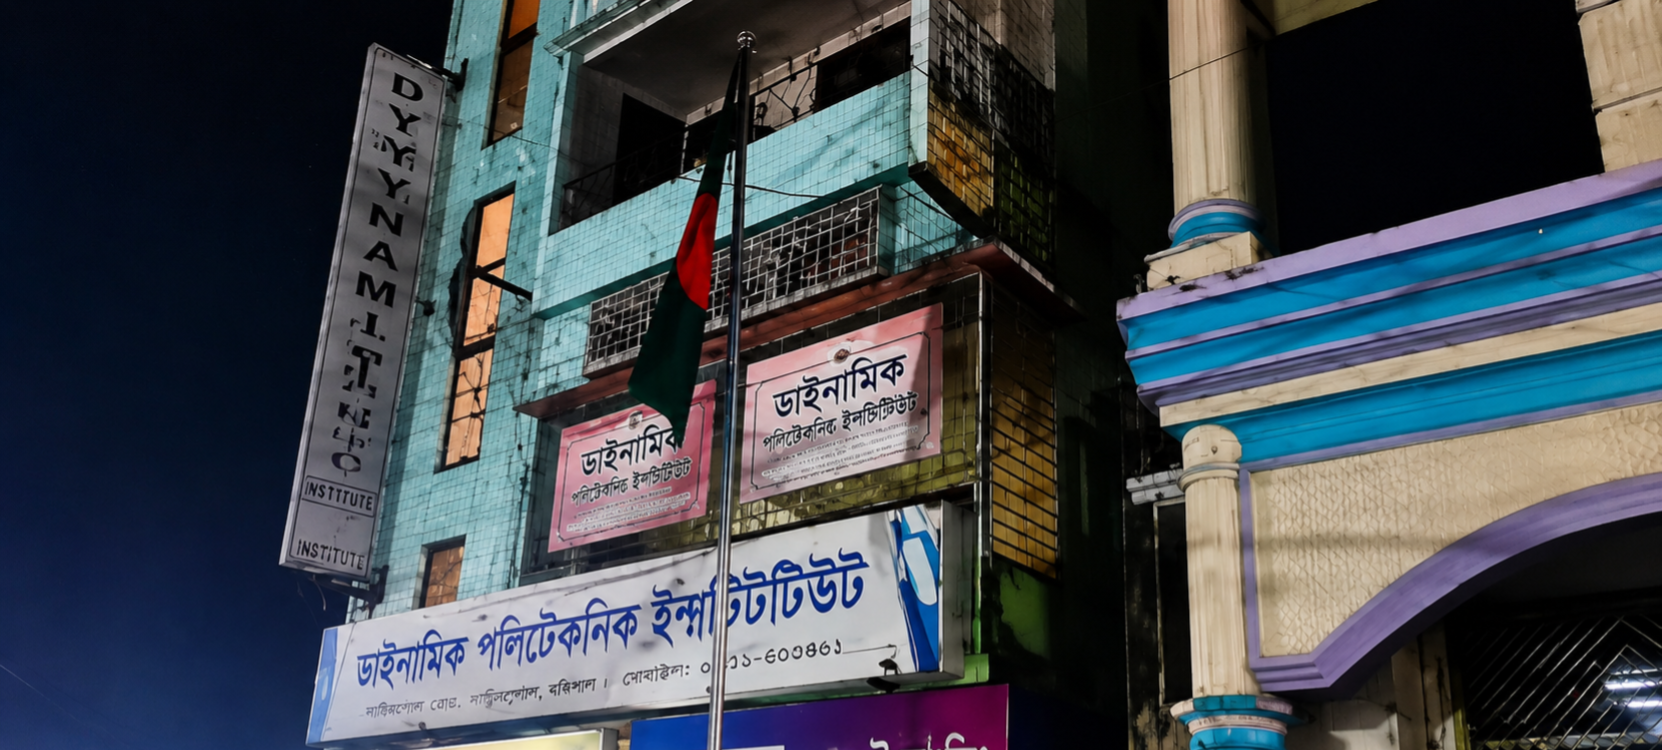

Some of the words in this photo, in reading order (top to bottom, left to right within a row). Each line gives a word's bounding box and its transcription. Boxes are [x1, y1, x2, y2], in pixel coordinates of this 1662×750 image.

[772, 354, 907, 417] ডাইনামিক
[296, 539, 365, 570] INSTITUTE
[357, 628, 469, 691] ডাইনামিক
[477, 597, 641, 671] পলিটেকনিক
